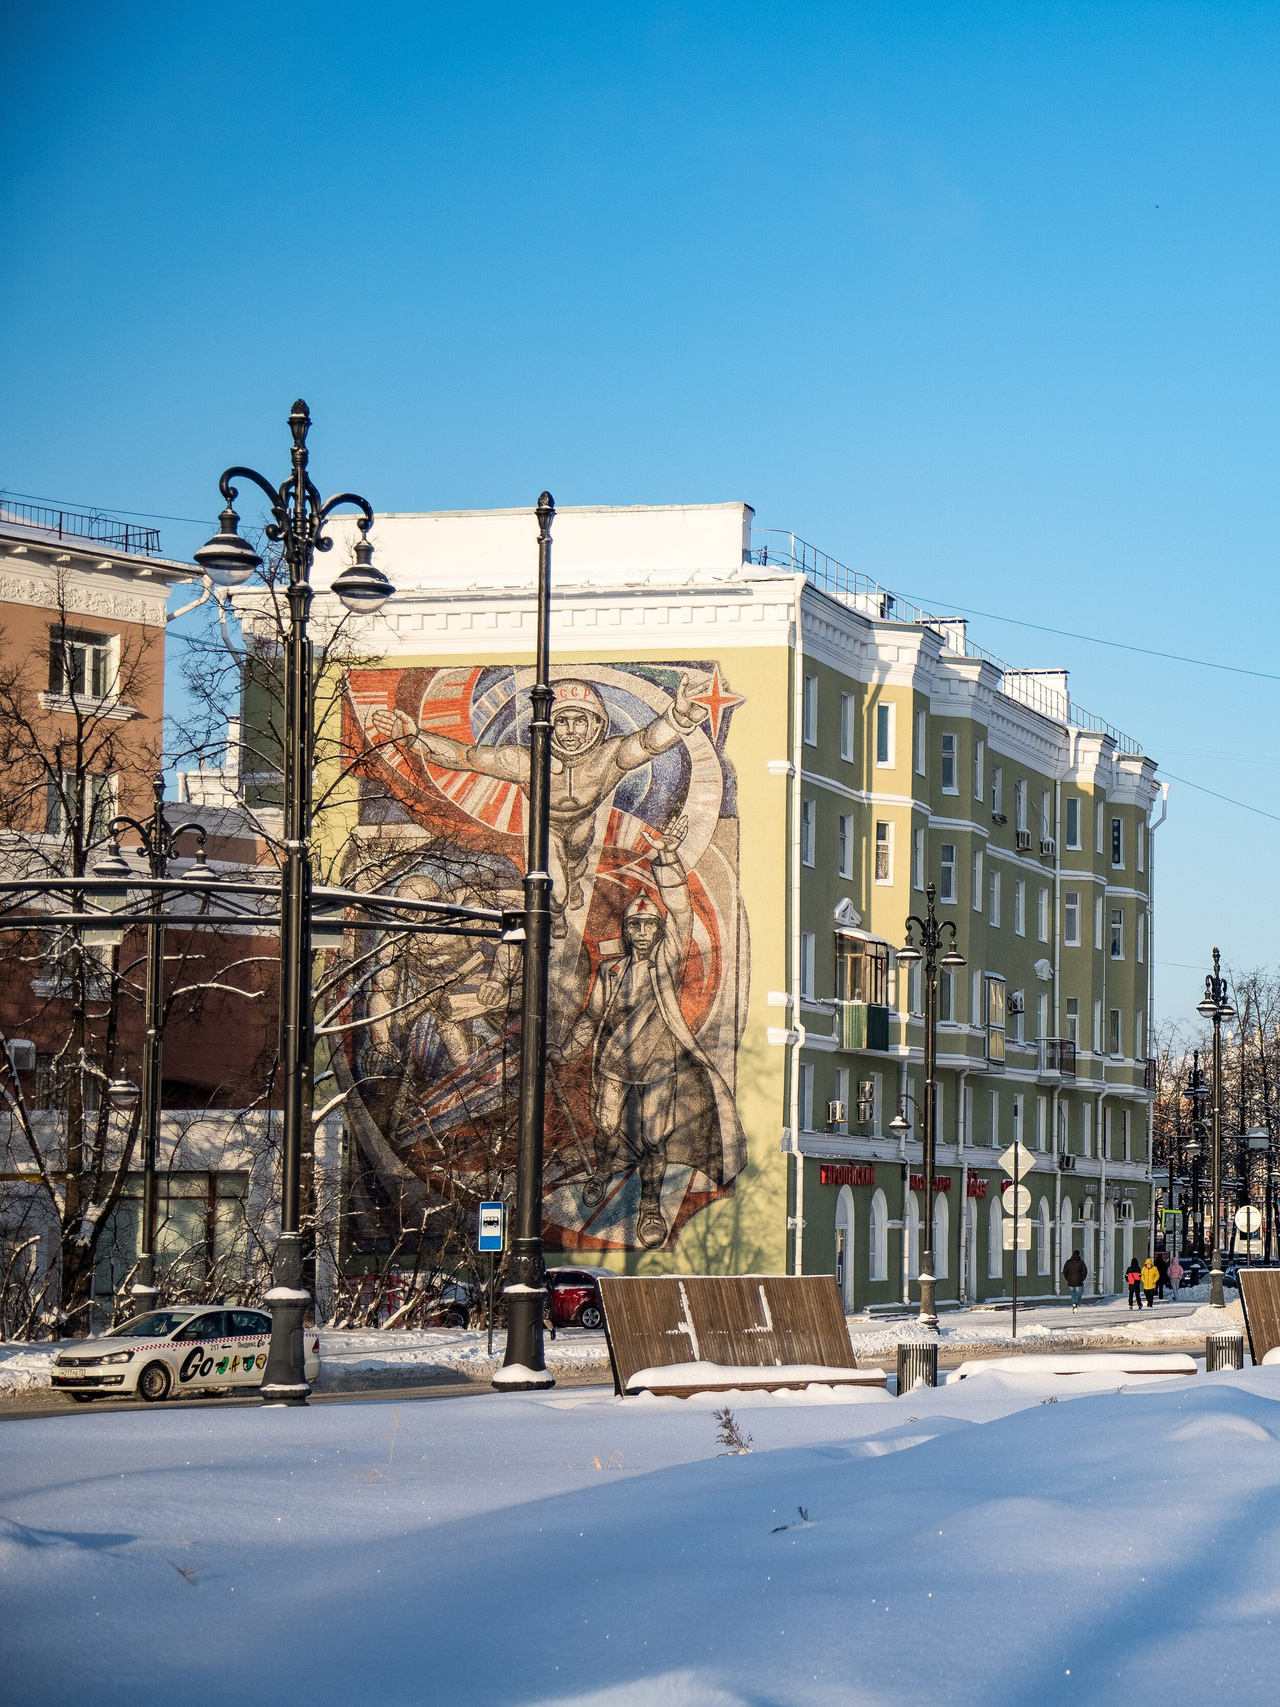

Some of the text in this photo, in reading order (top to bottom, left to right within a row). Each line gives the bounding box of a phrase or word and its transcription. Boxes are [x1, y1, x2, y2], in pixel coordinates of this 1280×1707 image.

[553, 686, 591, 703] ССР
[820, 1161, 875, 1185] ЕВРОПЕЙСКИЙ
[237, 1341, 257, 1349] Яндекс
[179, 1346, 214, 1383] Go
